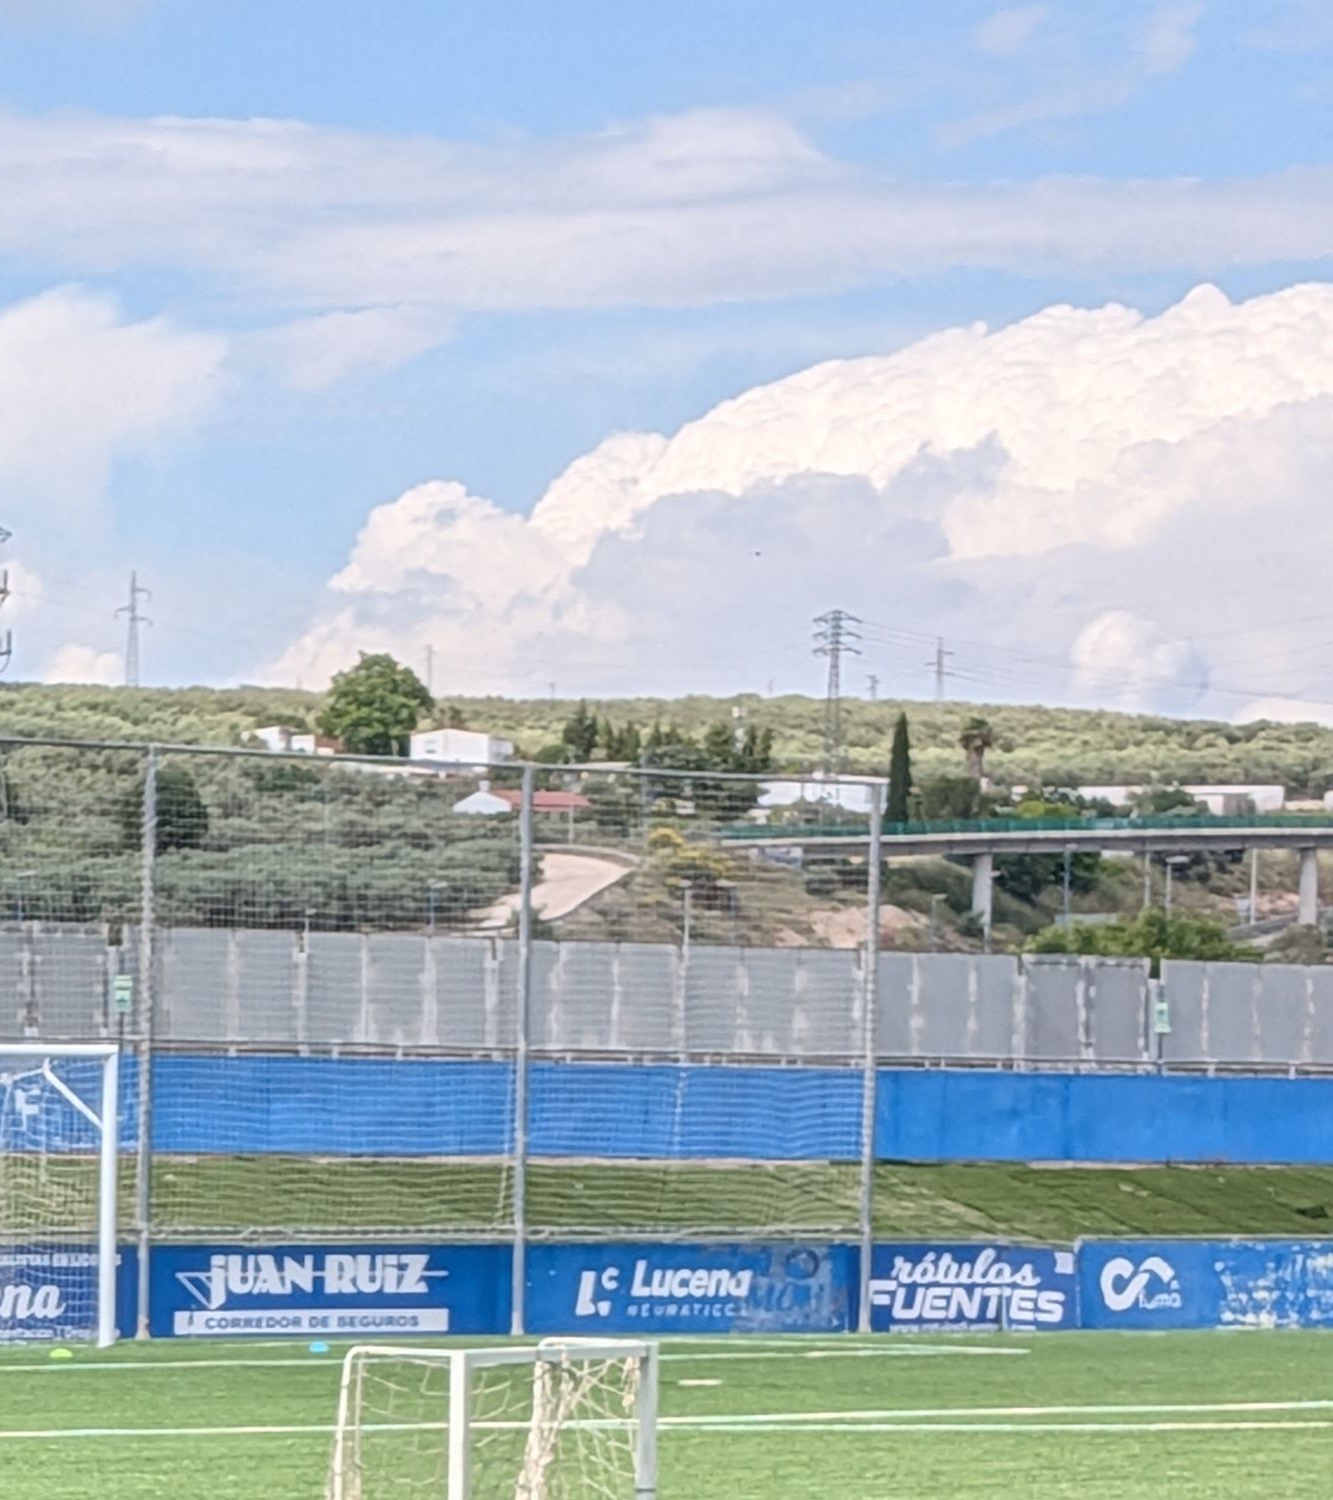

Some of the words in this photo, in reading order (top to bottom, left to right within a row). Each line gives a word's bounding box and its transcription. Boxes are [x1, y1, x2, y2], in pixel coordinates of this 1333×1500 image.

[630, 1259, 754, 1298] Lucena
[890, 1247, 1042, 1287] rótulos
[869, 1279, 1066, 1323] FUENTES
[204, 1316, 303, 1330] CORREDOR
[308, 1316, 331, 1329] DE
[337, 1315, 420, 1328] SEGUROS
